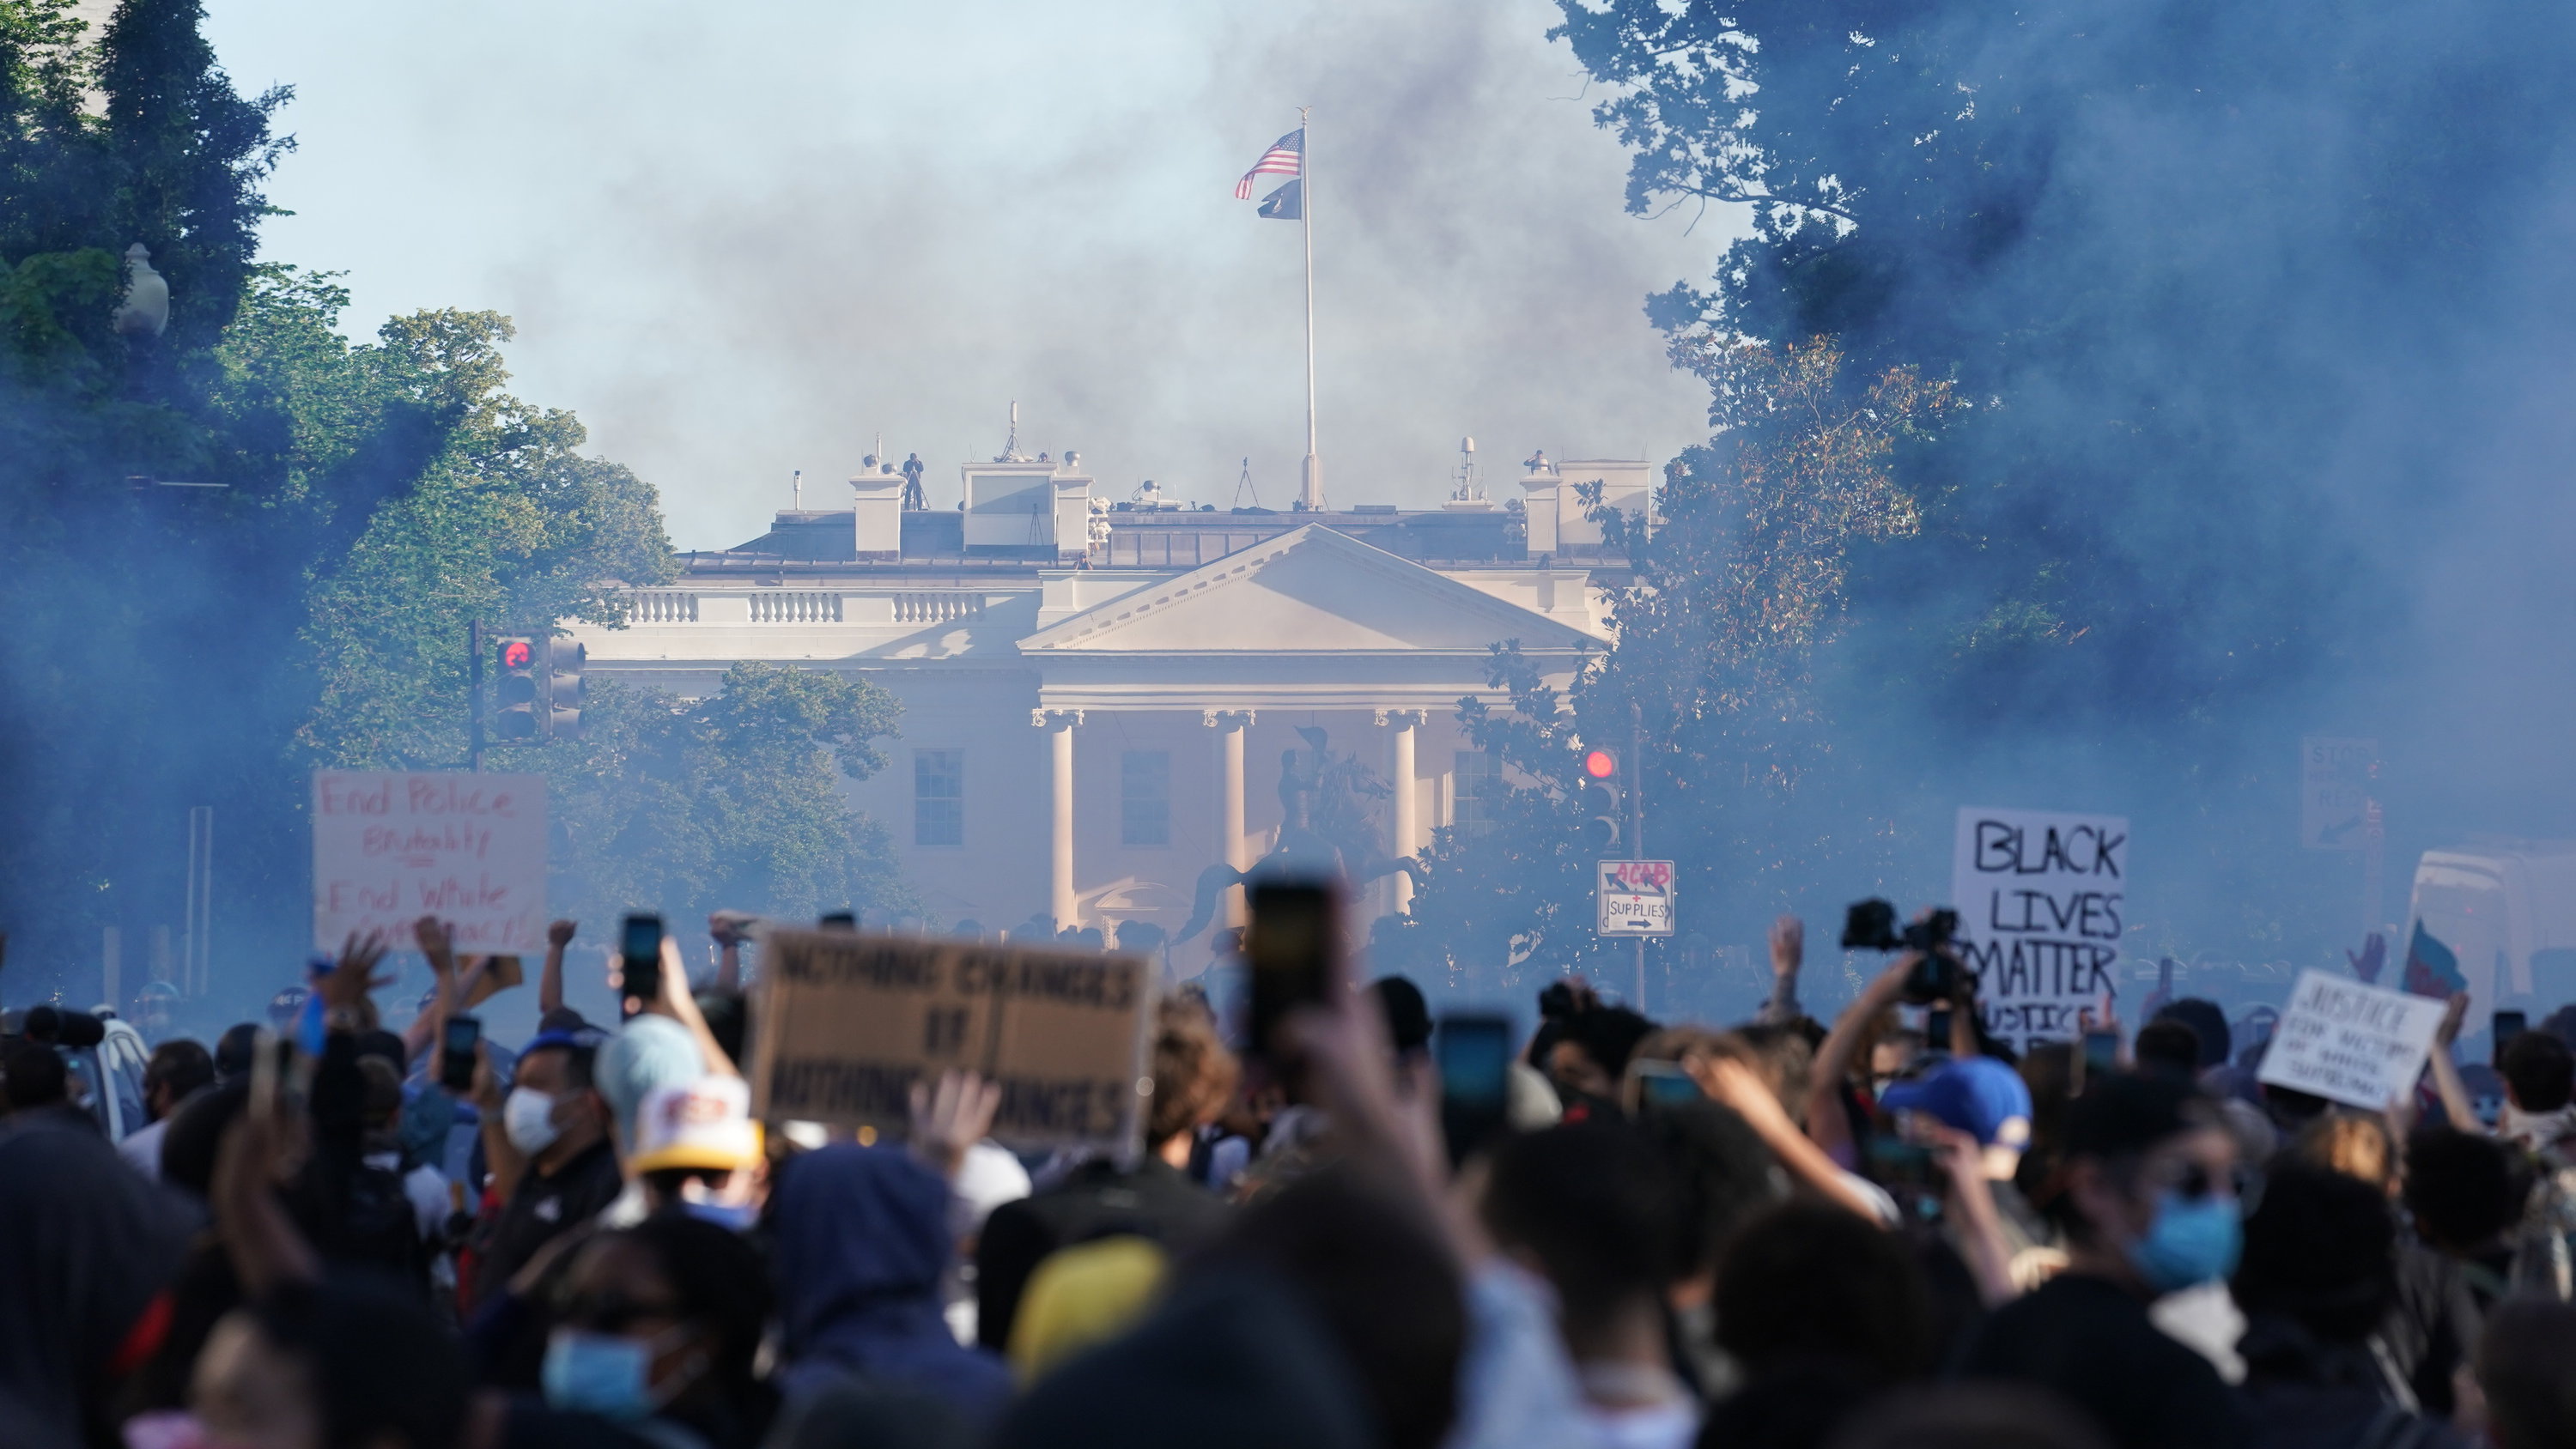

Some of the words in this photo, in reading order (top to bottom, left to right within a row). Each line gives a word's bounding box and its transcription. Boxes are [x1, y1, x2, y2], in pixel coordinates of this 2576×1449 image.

[320, 776, 392, 816] End
[408, 774, 519, 819] Police
[1975, 820, 2127, 879] BLACK
[329, 877, 401, 913] End
[419, 870, 510, 912] White
[1613, 863, 1670, 886] ACAB
[1610, 900, 1665, 918] SUPPLIES
[1990, 888, 2124, 940] LIVES
[1961, 937, 2118, 999] MATTER
[1982, 1002, 2099, 1032] USTICE
